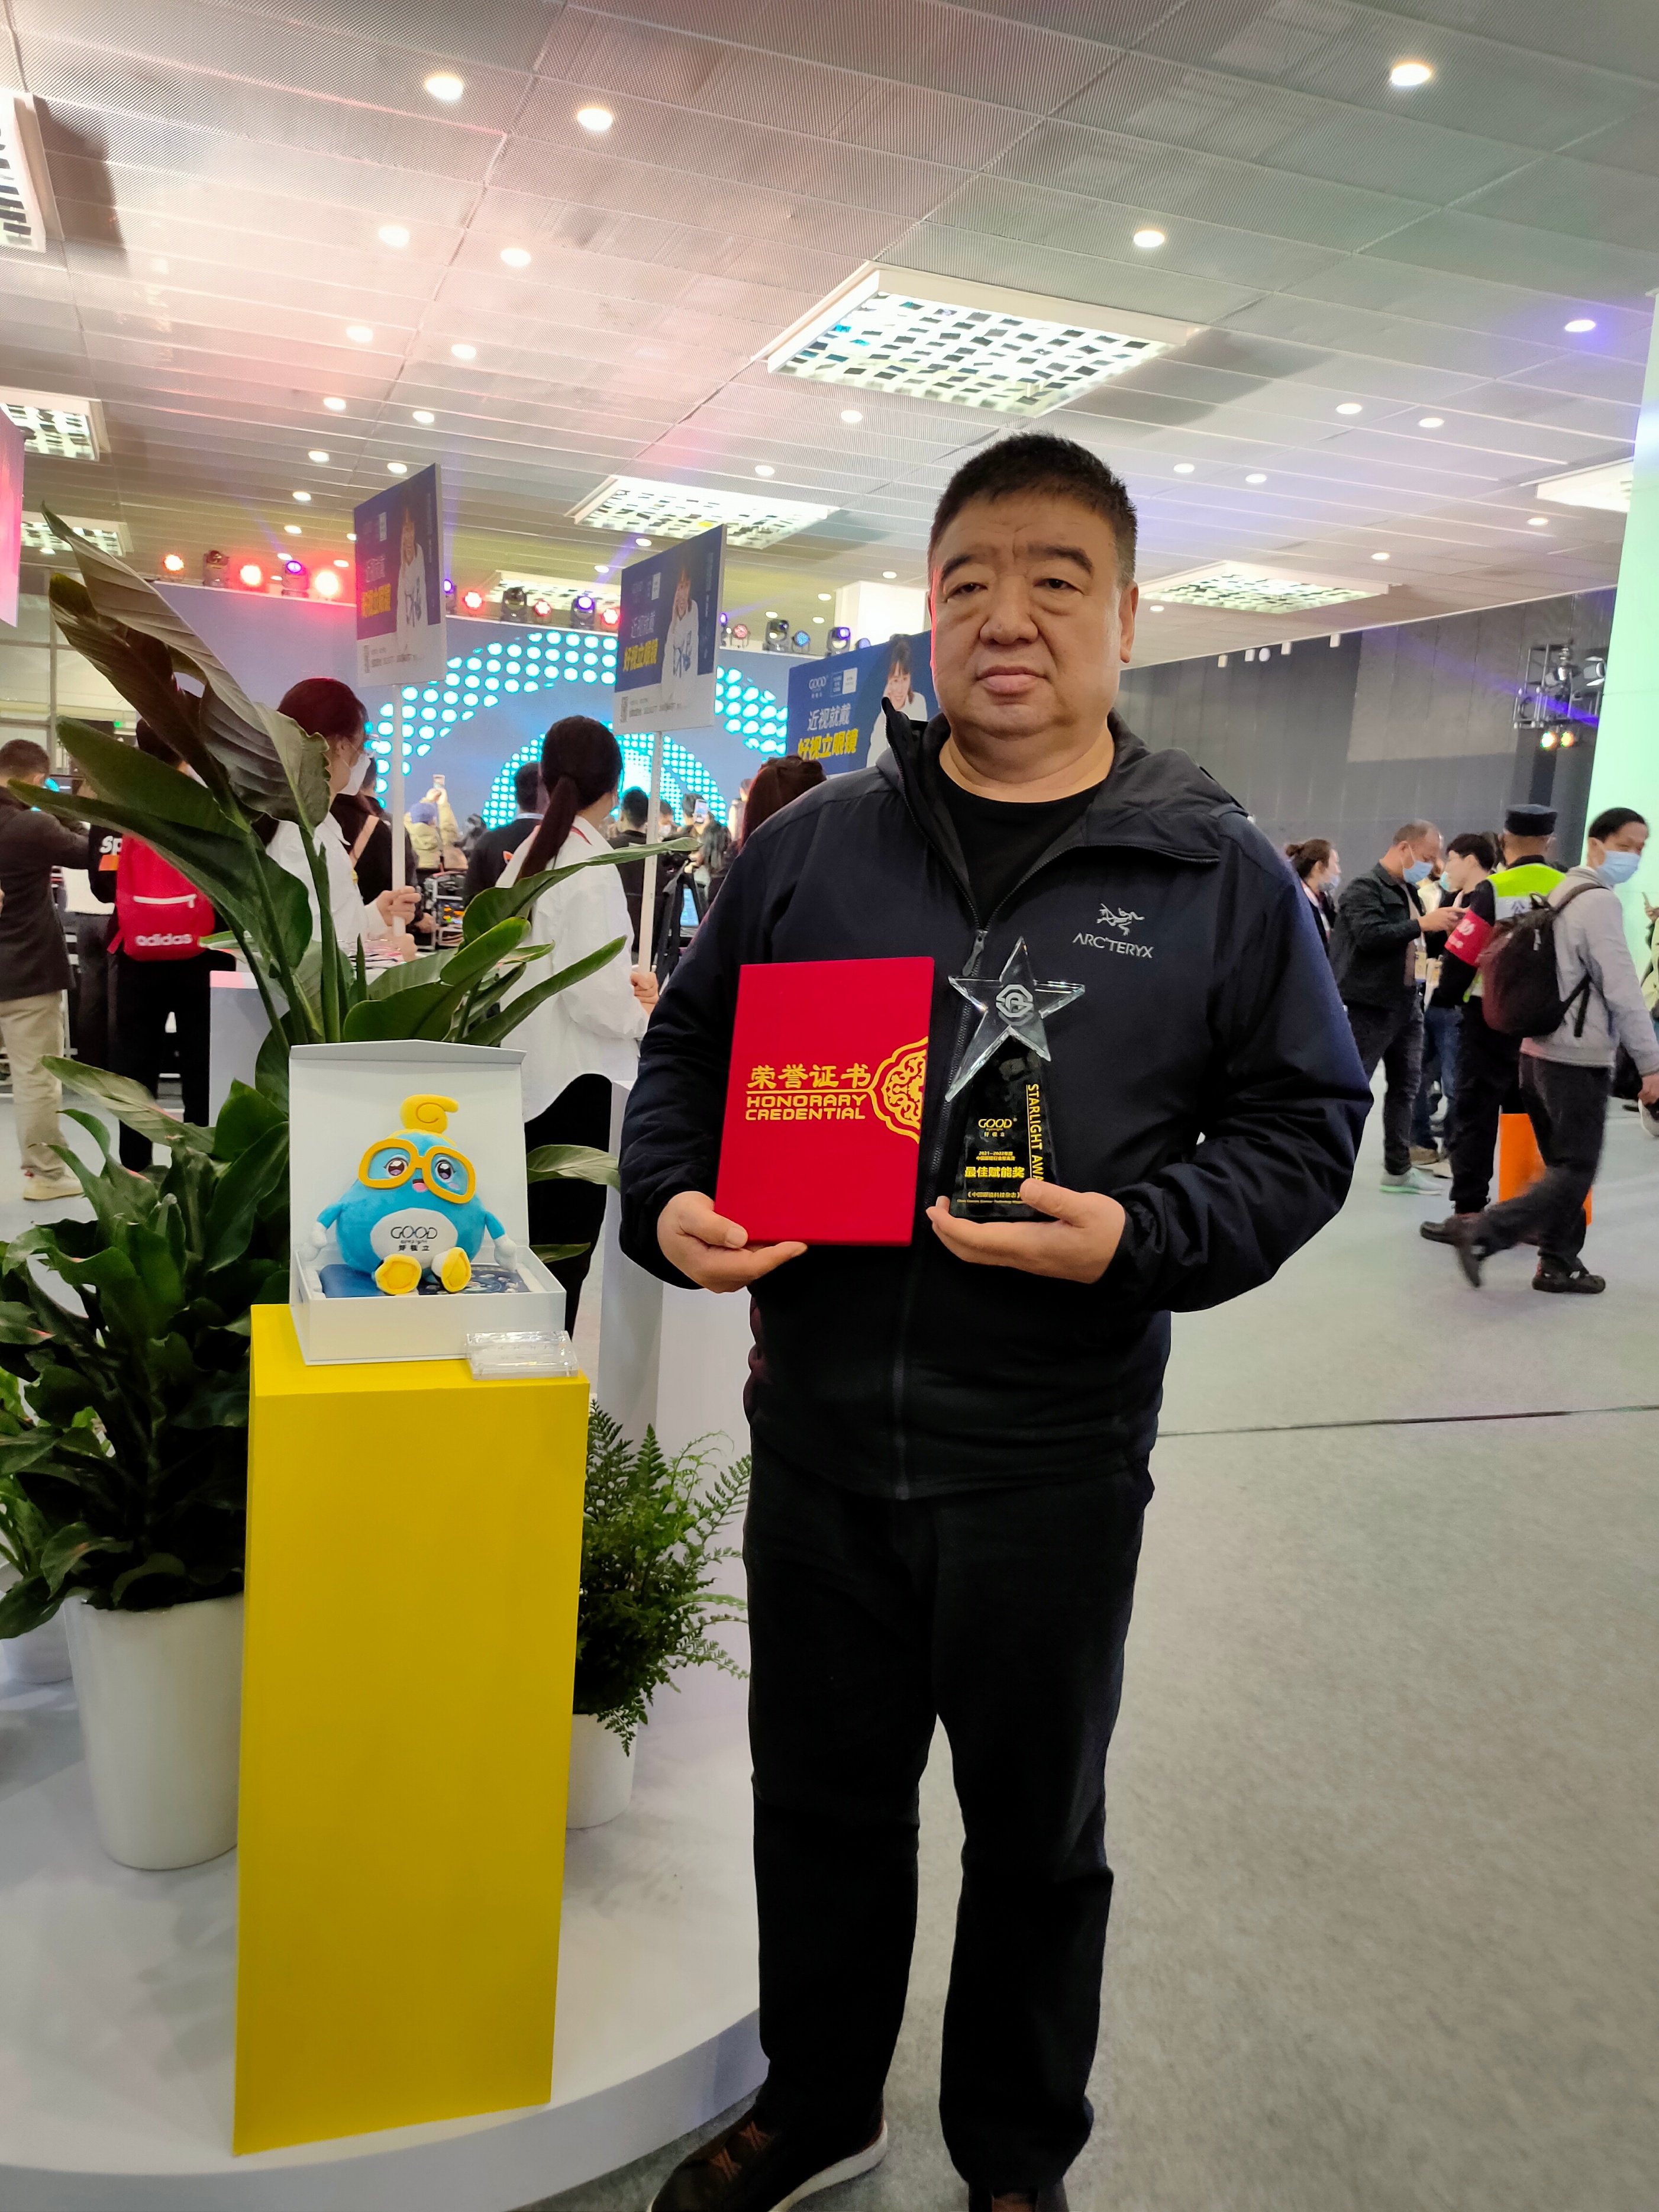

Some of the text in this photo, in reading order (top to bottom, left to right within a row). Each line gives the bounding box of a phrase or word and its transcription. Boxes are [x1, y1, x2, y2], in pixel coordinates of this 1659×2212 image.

[807, 703, 851, 731] 近视就戴
[798, 728, 858, 760] 好视立眼镜
[135, 933, 192, 946] adidas
[747, 1063, 871, 1089] 荣誉证书
[747, 1094, 867, 1108] HONORARY
[745, 1107, 866, 1120] CREDENTIAL
[978, 1118, 1012, 1128] GOOD
[1028, 1084, 1044, 1182] STARLIGHT AWA
[964, 1166, 1025, 1178] 最佳赋能奖
[390, 1226, 438, 1239] GOOD
